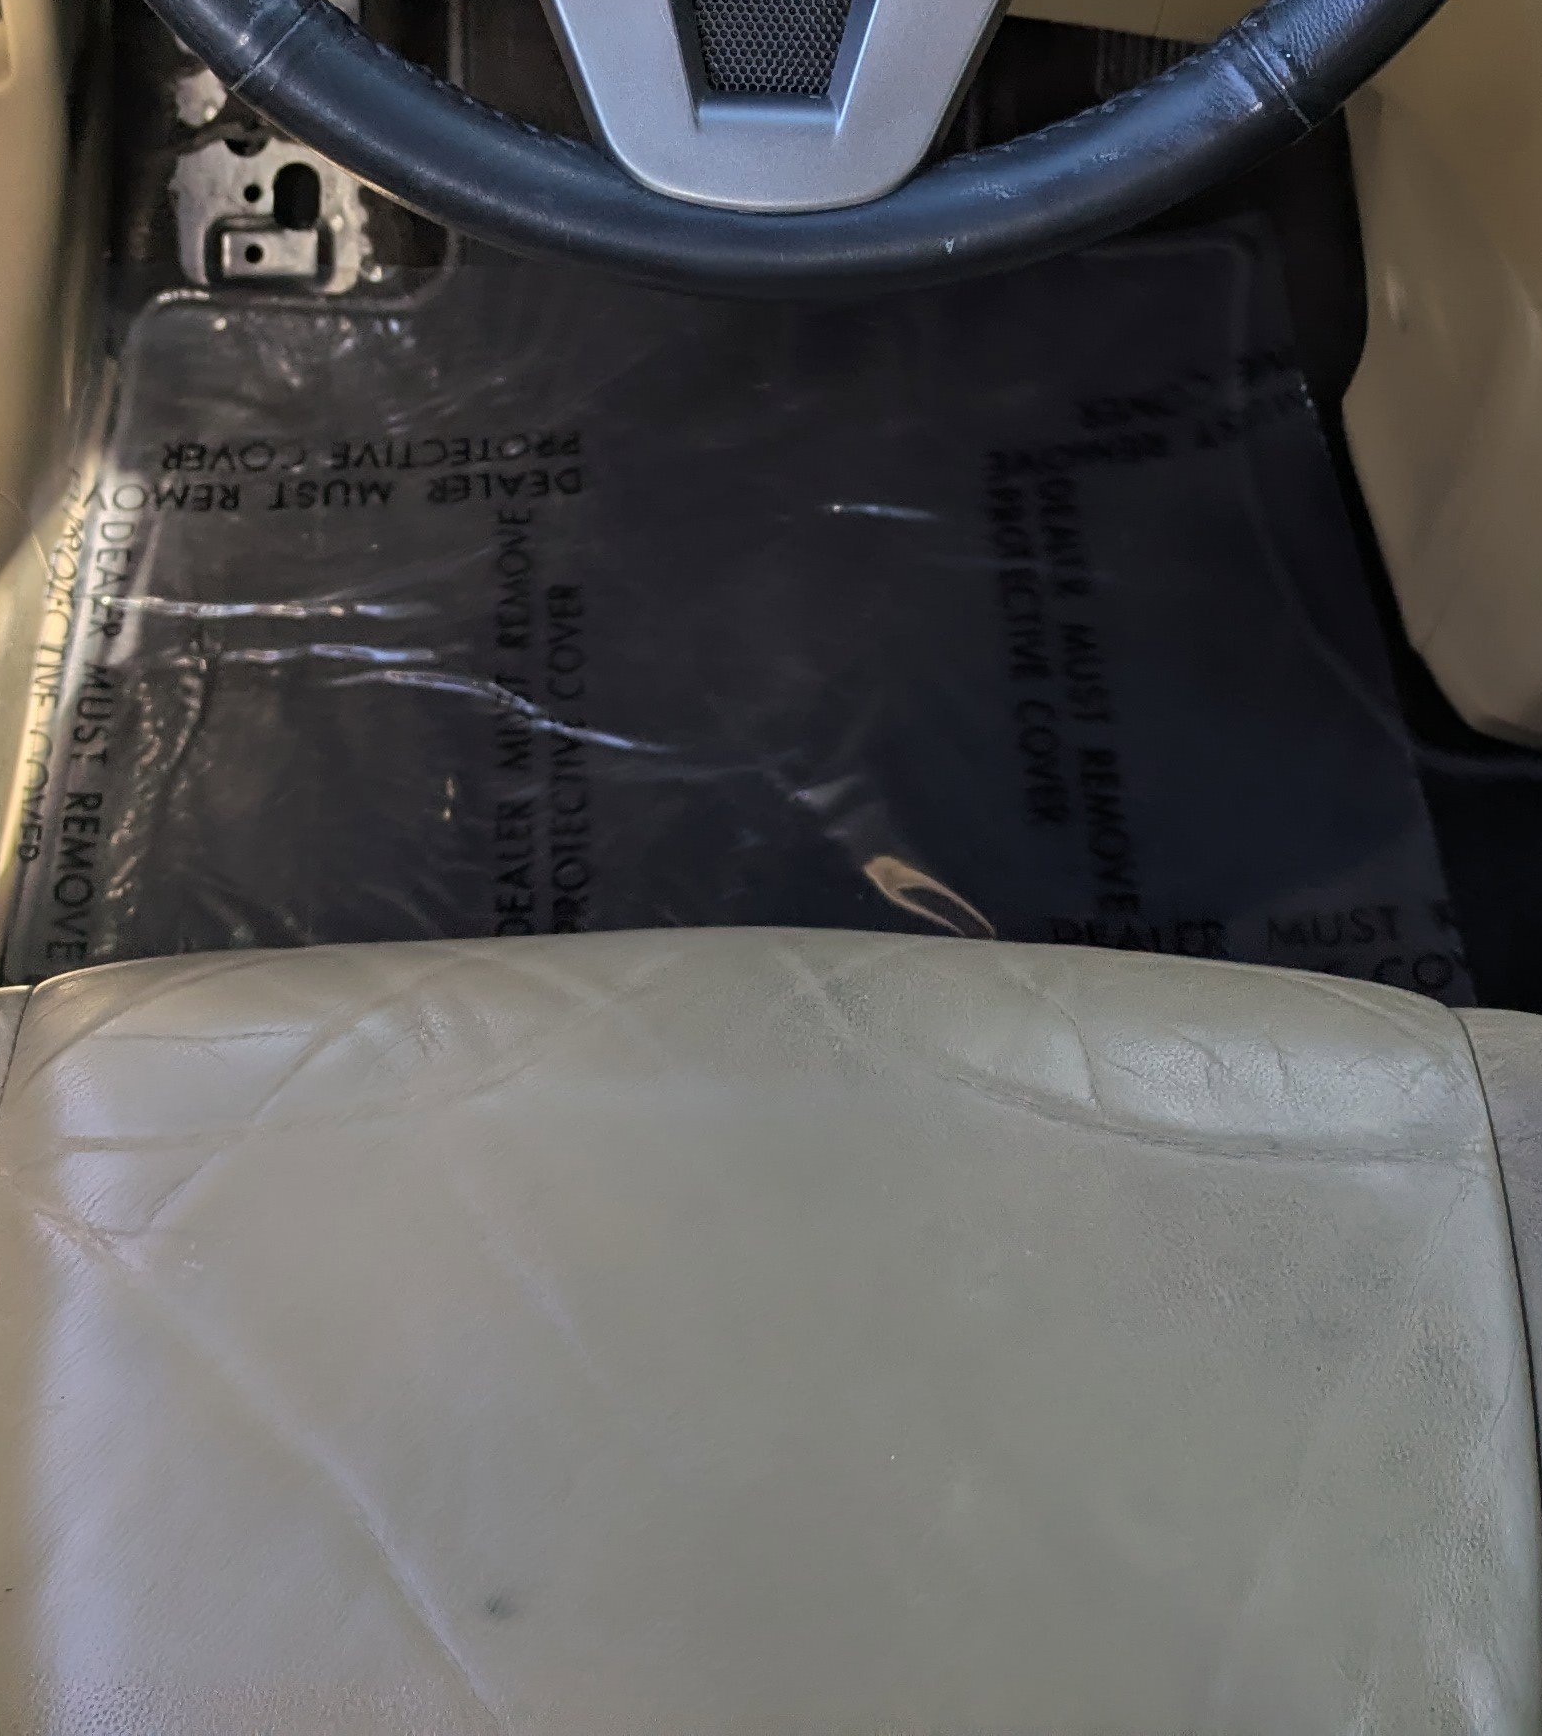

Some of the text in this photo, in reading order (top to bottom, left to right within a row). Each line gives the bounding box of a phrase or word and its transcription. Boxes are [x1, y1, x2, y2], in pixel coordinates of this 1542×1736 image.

[160, 430, 582, 473] PROTECTIVE COVER
[267, 477, 395, 512] MUST
[427, 465, 584, 506] DEALER
[493, 507, 532, 651] REMOVE
[546, 584, 587, 702] COVER
[72, 664, 116, 768] MUST
[46, 790, 104, 963] REMOVE
[1079, 749, 1140, 918] REMOVE
[1266, 904, 1399, 947] MUST
